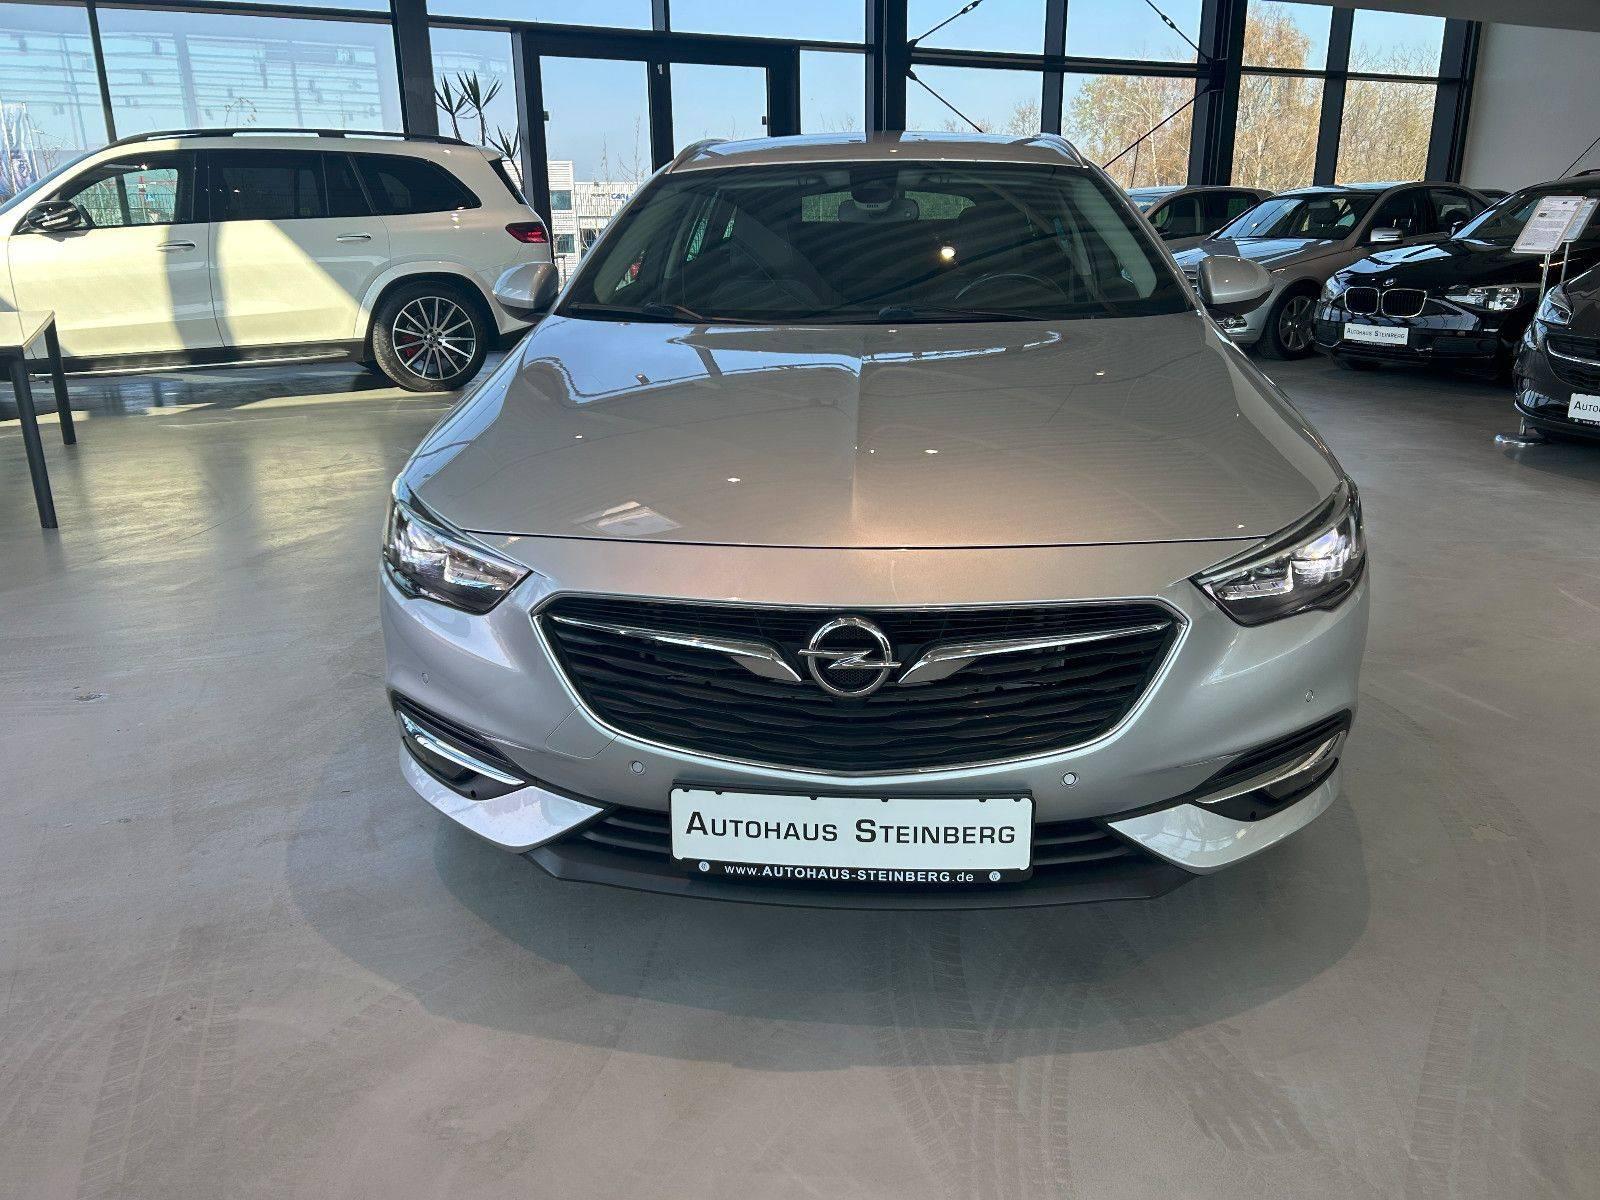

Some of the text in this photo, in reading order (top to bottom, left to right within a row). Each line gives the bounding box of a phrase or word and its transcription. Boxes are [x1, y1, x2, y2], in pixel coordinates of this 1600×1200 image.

[1573, 400, 1600, 413] AUTO
[685, 811, 1016, 845] AUTOHAUS STEINBERG
[723, 864, 975, 882] www.AUTOHAUS-STEINBERG.de
